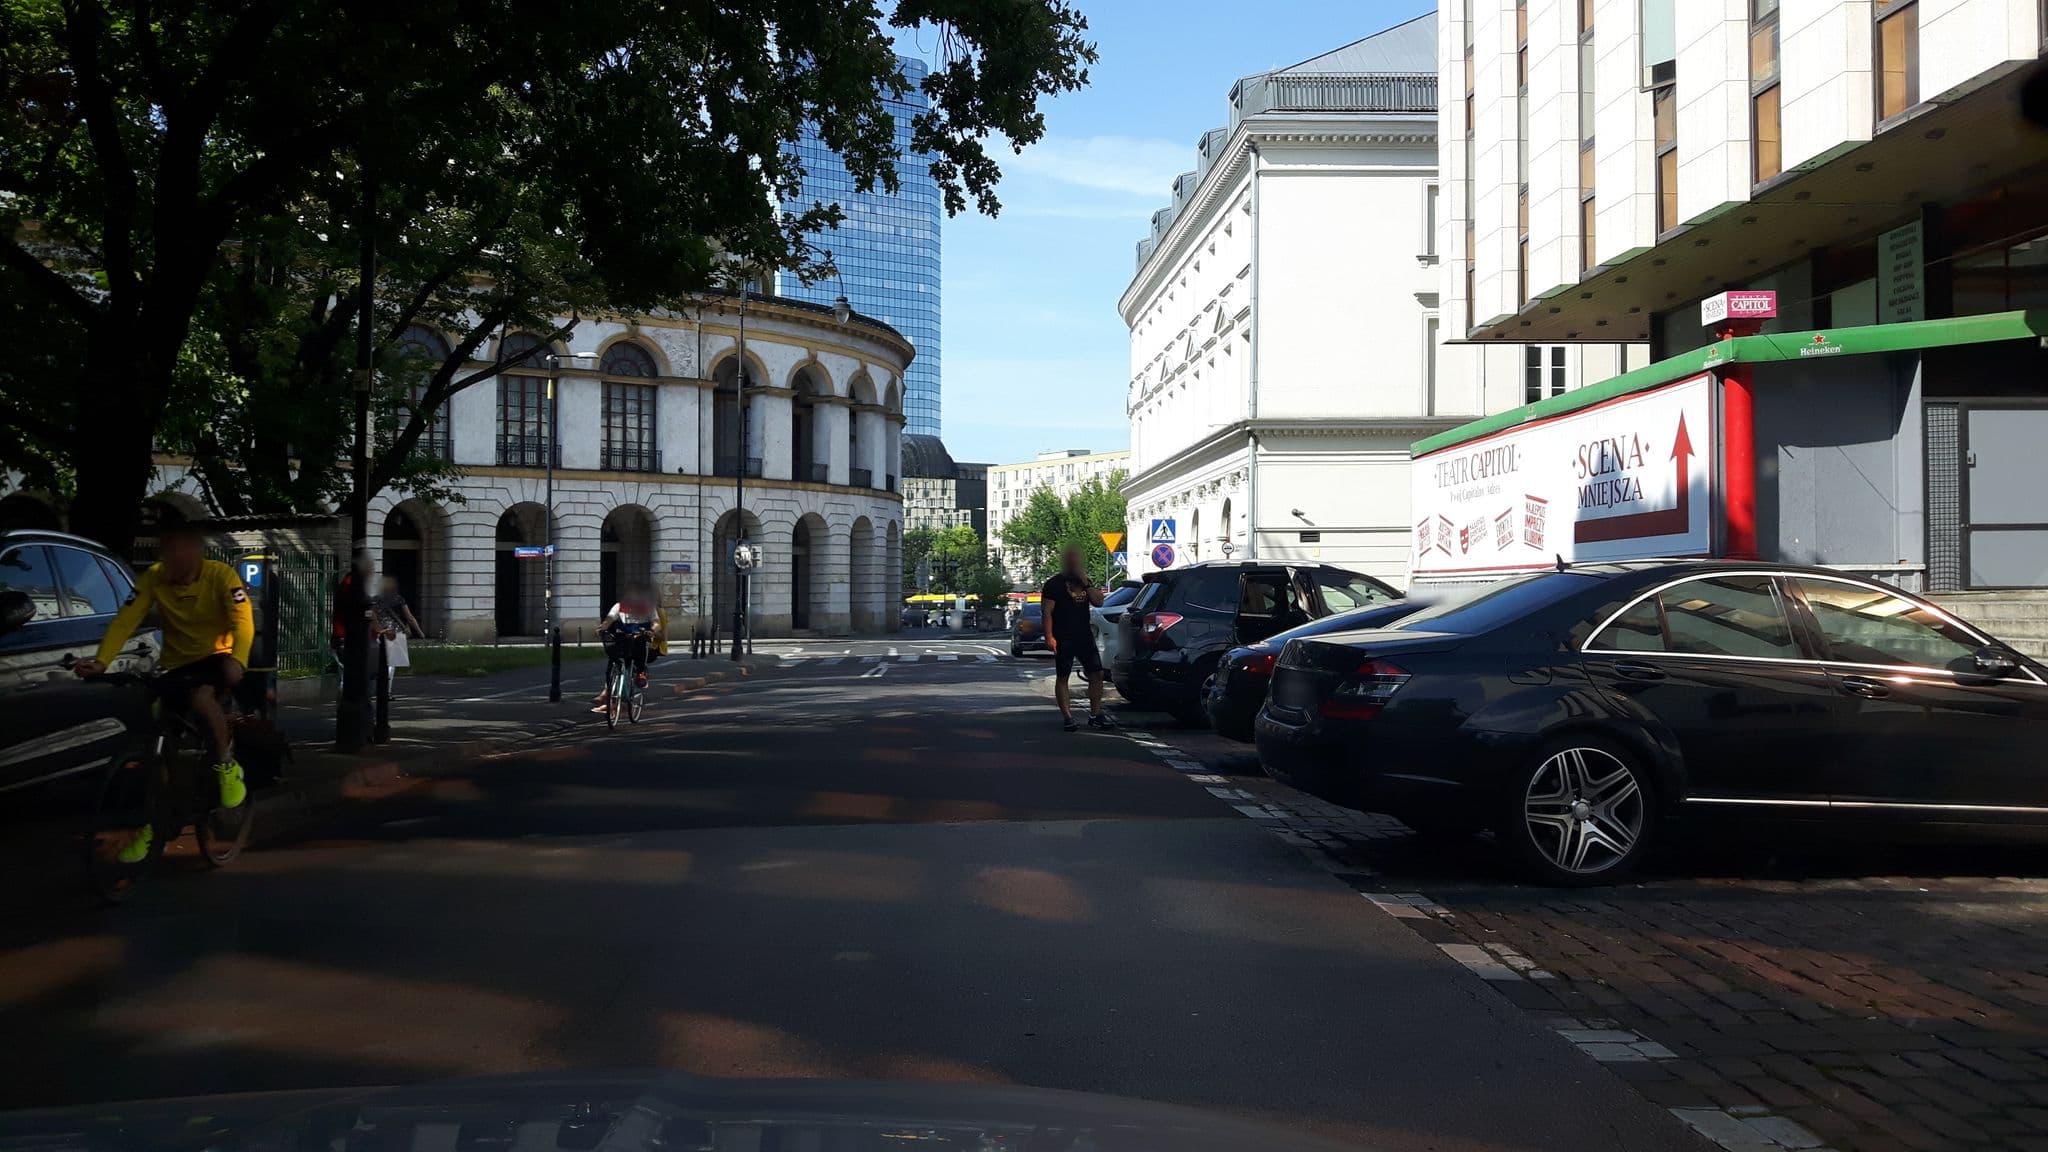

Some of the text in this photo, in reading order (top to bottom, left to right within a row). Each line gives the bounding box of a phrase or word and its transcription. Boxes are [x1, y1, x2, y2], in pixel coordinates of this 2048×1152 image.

[1731, 300, 1770, 310] CAPITOL
[1800, 345, 1841, 356] Heineken
[1436, 444, 1519, 488] TEATR CAPITOL
[1578, 432, 1645, 479] SCENA
[1578, 476, 1644, 509] MNIEJSZA
[246, 564, 259, 582] P
